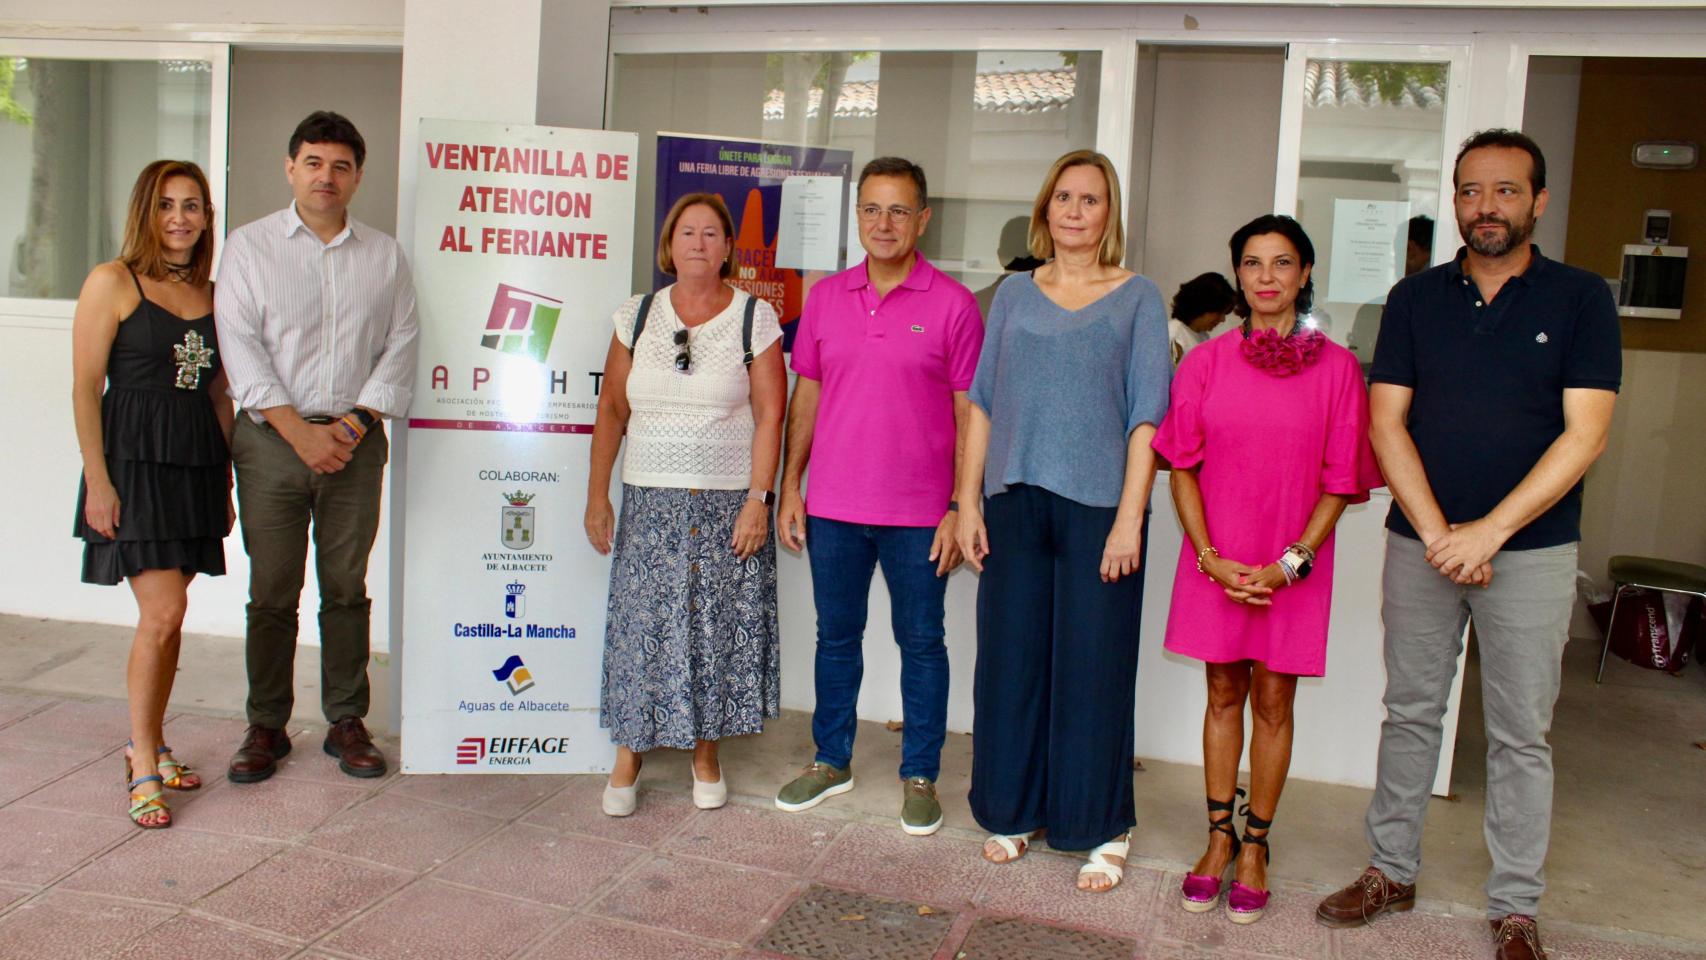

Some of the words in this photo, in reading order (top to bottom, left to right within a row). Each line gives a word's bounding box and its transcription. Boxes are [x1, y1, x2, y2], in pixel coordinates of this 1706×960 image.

[425, 142, 588, 178] VENTANILLA
[596, 153, 629, 181] DE
[719, 147, 742, 161] ÚNETE
[743, 151, 761, 163] PARA
[679, 161, 696, 172] UNA
[696, 162, 718, 175] FERIA
[718, 164, 739, 176] LIBRE
[740, 166, 750, 176] DE
[458, 185, 592, 219] ATENCION
[439, 225, 473, 253] AL
[481, 227, 608, 260] FERIANTE
[739, 266, 756, 280] NO
[479, 470, 560, 483] COLABORAN:
[482, 553, 553, 562] AYUNTAMIENTO
[486, 563, 499, 571] DE
[500, 563, 548, 572] ALBACETE
[454, 623, 522, 638] Castilla-La
[526, 624, 576, 639] Mancha
[458, 700, 496, 714] Aguas
[500, 700, 514, 711] de
[518, 700, 570, 712] Albacete
[489, 737, 570, 754] EIFFAGE
[489, 756, 532, 765] ENERGIA
